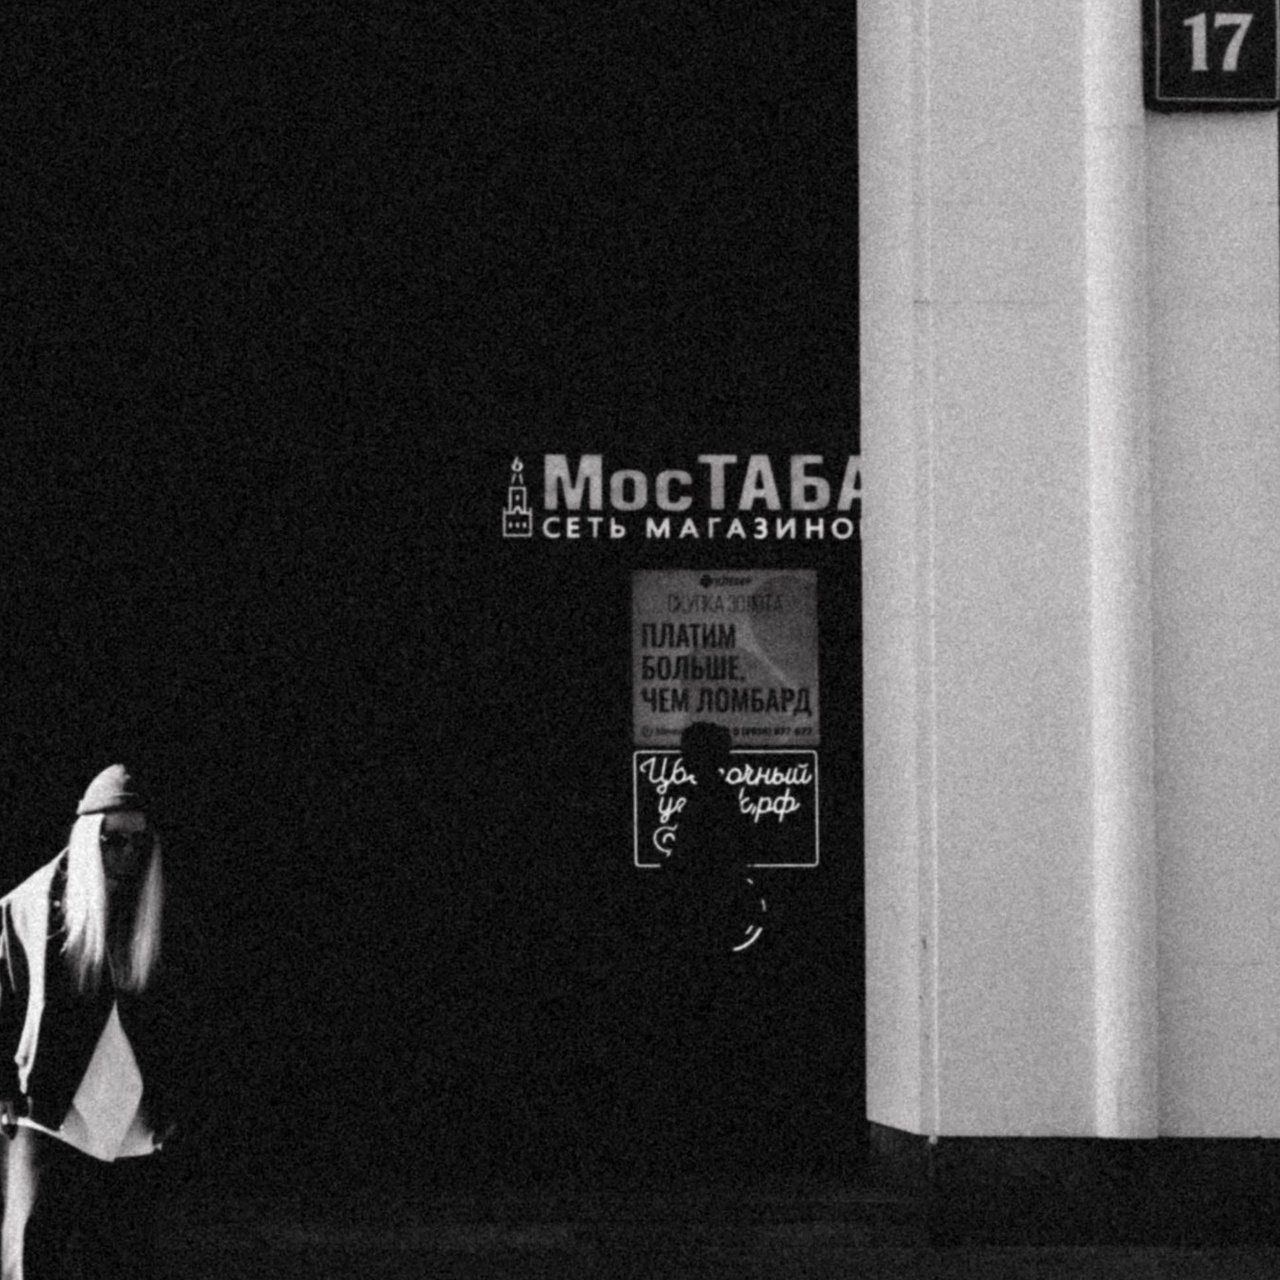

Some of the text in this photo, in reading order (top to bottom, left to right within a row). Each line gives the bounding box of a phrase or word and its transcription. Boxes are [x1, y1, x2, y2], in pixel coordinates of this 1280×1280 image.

[1183, 12, 1254, 72] 17
[542, 516, 855, 541] СЕТЬ МАГАЗИНО
[641, 622, 736, 649] ПЛАТИМ
[641, 687, 812, 718] ЧЕМ ЛОМБАРД
